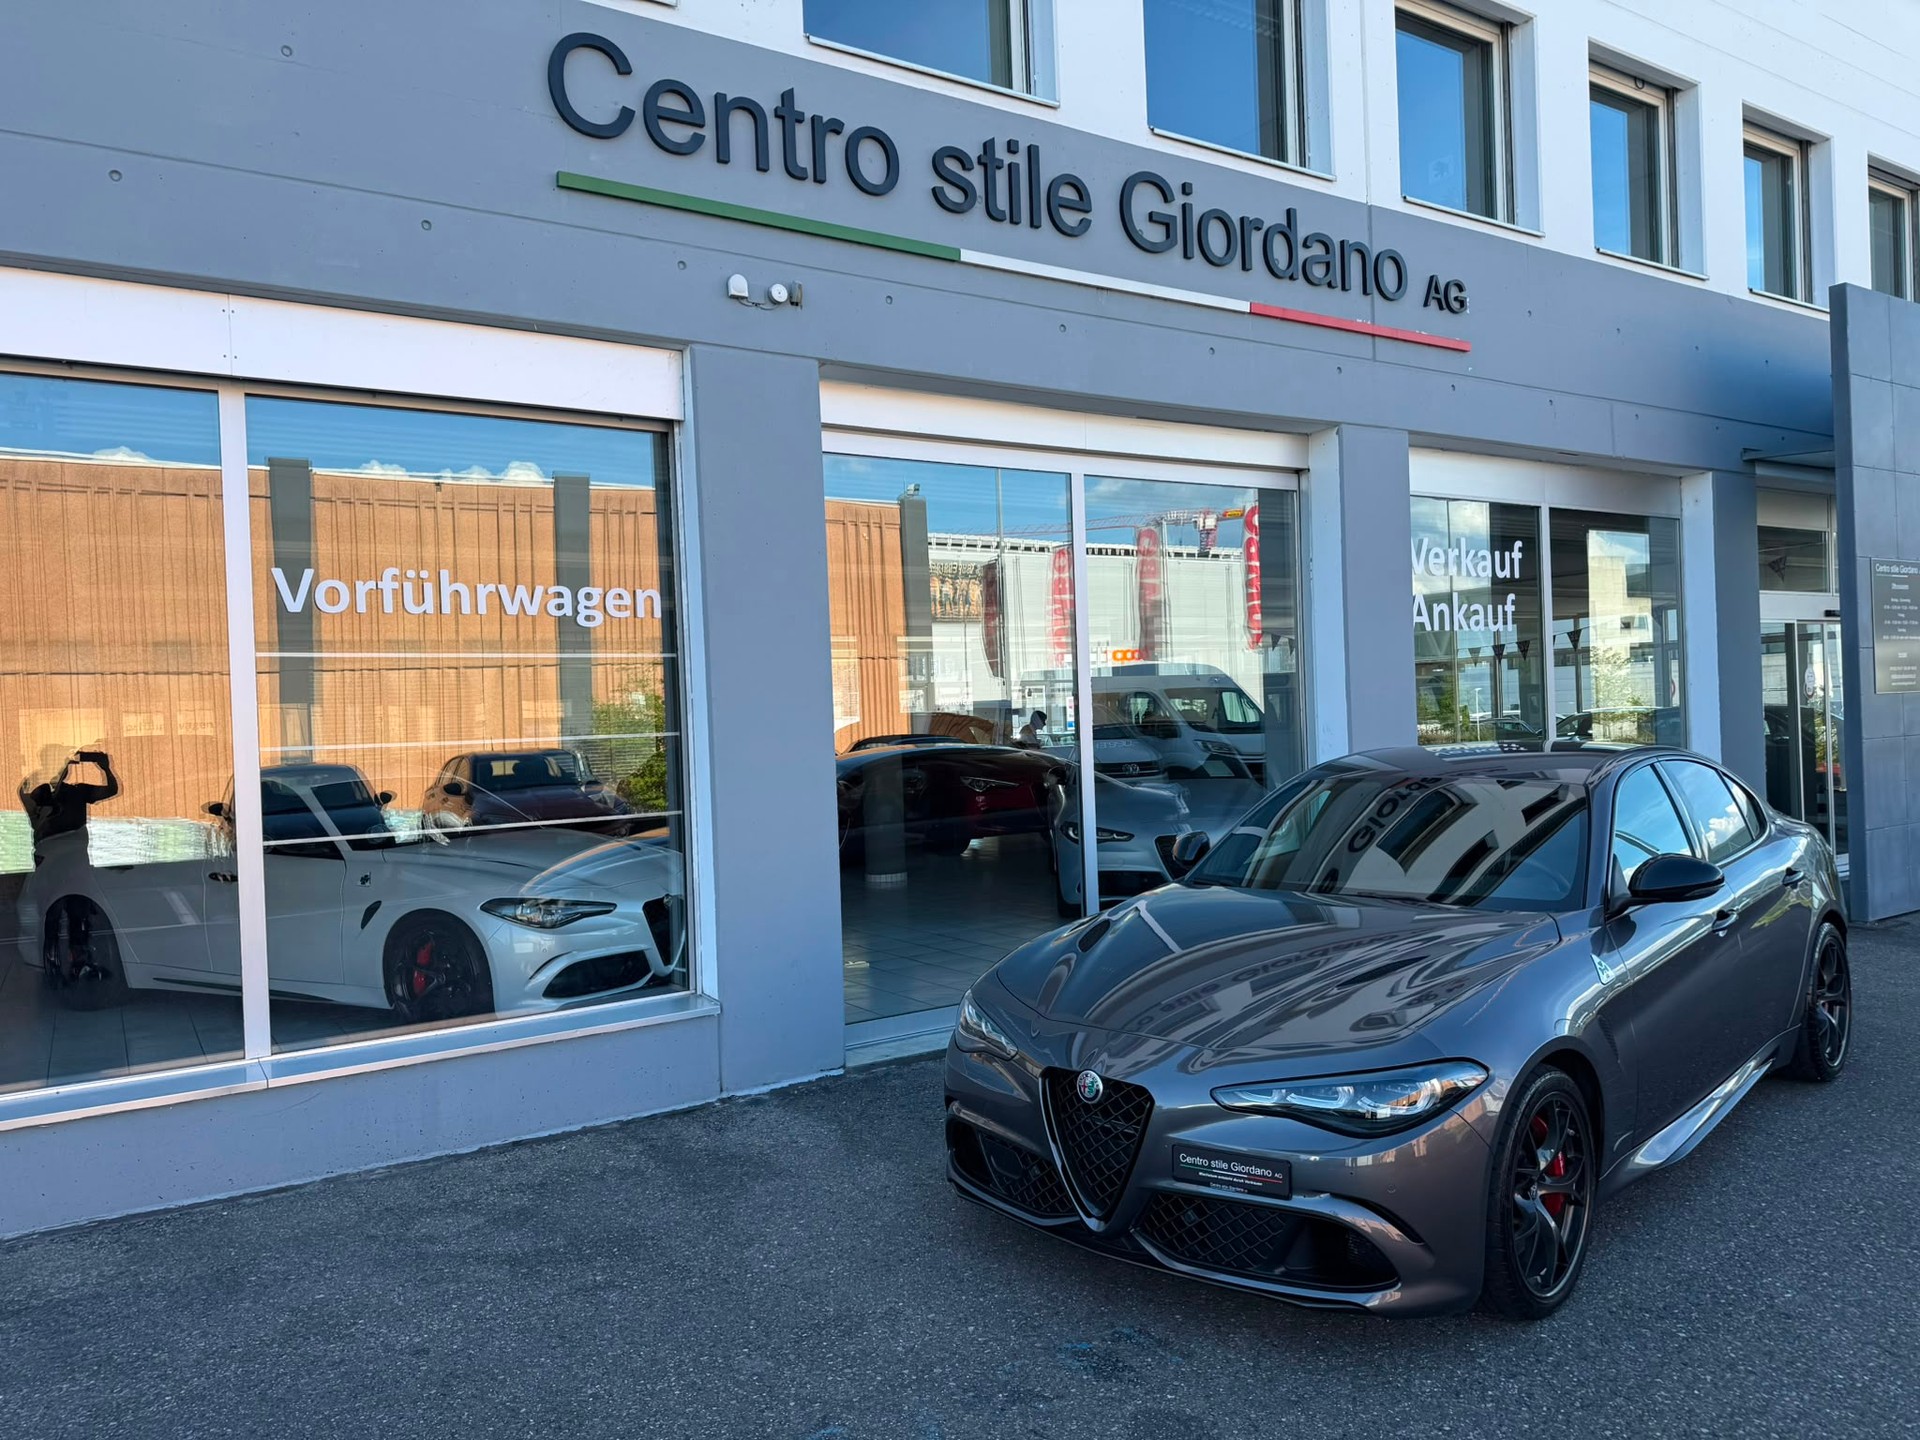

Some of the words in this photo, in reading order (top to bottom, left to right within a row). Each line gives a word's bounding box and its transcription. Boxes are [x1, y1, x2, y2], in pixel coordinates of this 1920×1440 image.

[547, 32, 900, 197] Centro
[931, 137, 1092, 238] stile
[1119, 171, 1408, 301] Giordano
[1423, 274, 1469, 314] AG
[1410, 537, 1523, 579] Verkauf
[1875, 563, 1890, 573] Centro
[271, 567, 662, 628] Vorführwagen
[1412, 592, 1516, 632] Ankauf
[1180, 1153, 1209, 1167] Centro
[1210, 1160, 1229, 1170] stile
[1230, 1162, 1272, 1177] Giordano
